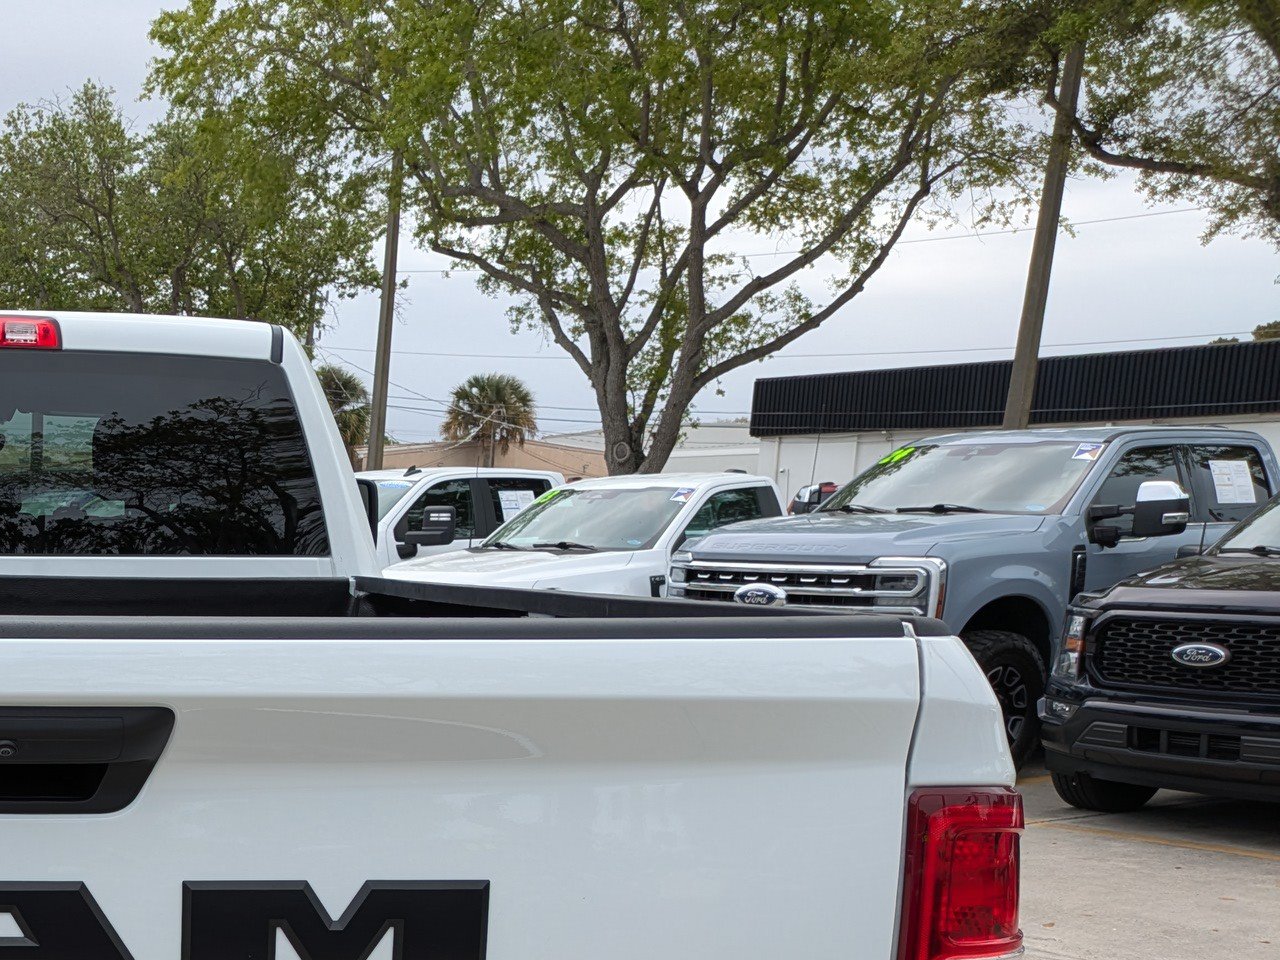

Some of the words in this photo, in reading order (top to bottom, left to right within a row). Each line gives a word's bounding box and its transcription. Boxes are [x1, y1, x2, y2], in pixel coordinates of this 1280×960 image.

[711, 542, 779, 552] SUPER
[783, 543, 848, 553] DUTY
[1182, 648, 1213, 662] Ford
